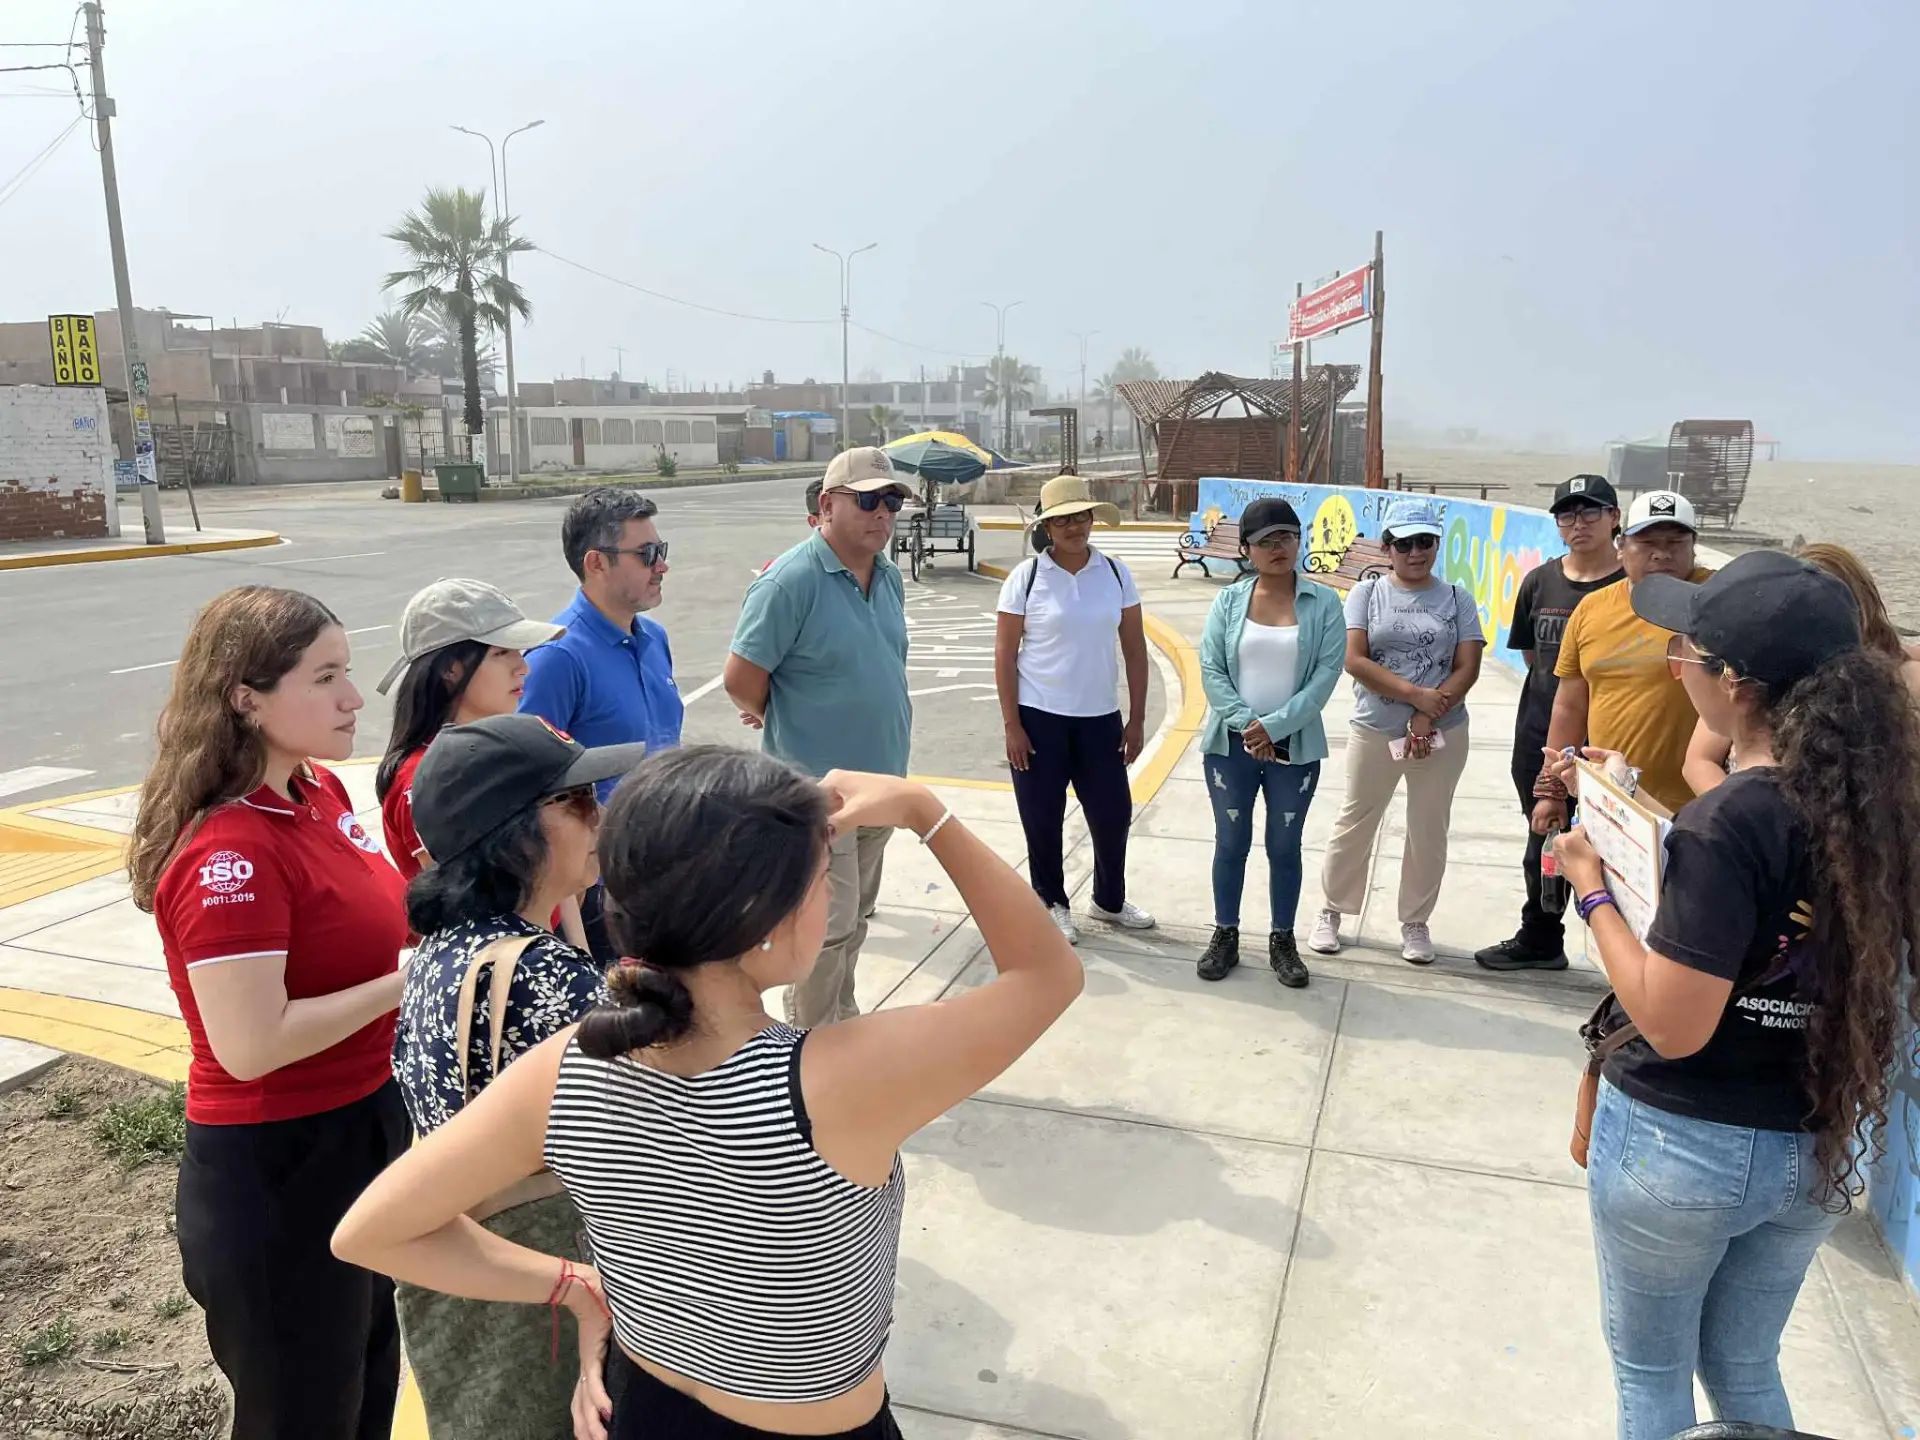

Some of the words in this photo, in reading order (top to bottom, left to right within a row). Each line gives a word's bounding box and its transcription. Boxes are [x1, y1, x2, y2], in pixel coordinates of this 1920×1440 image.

[54, 318, 70, 381] BAÑO
[77, 318, 94, 381] BAÑO
[73, 416, 96, 430] BAÑO
[199, 860, 253, 886] ISO
[1736, 996, 1818, 1016] ASOCIACIÓ
